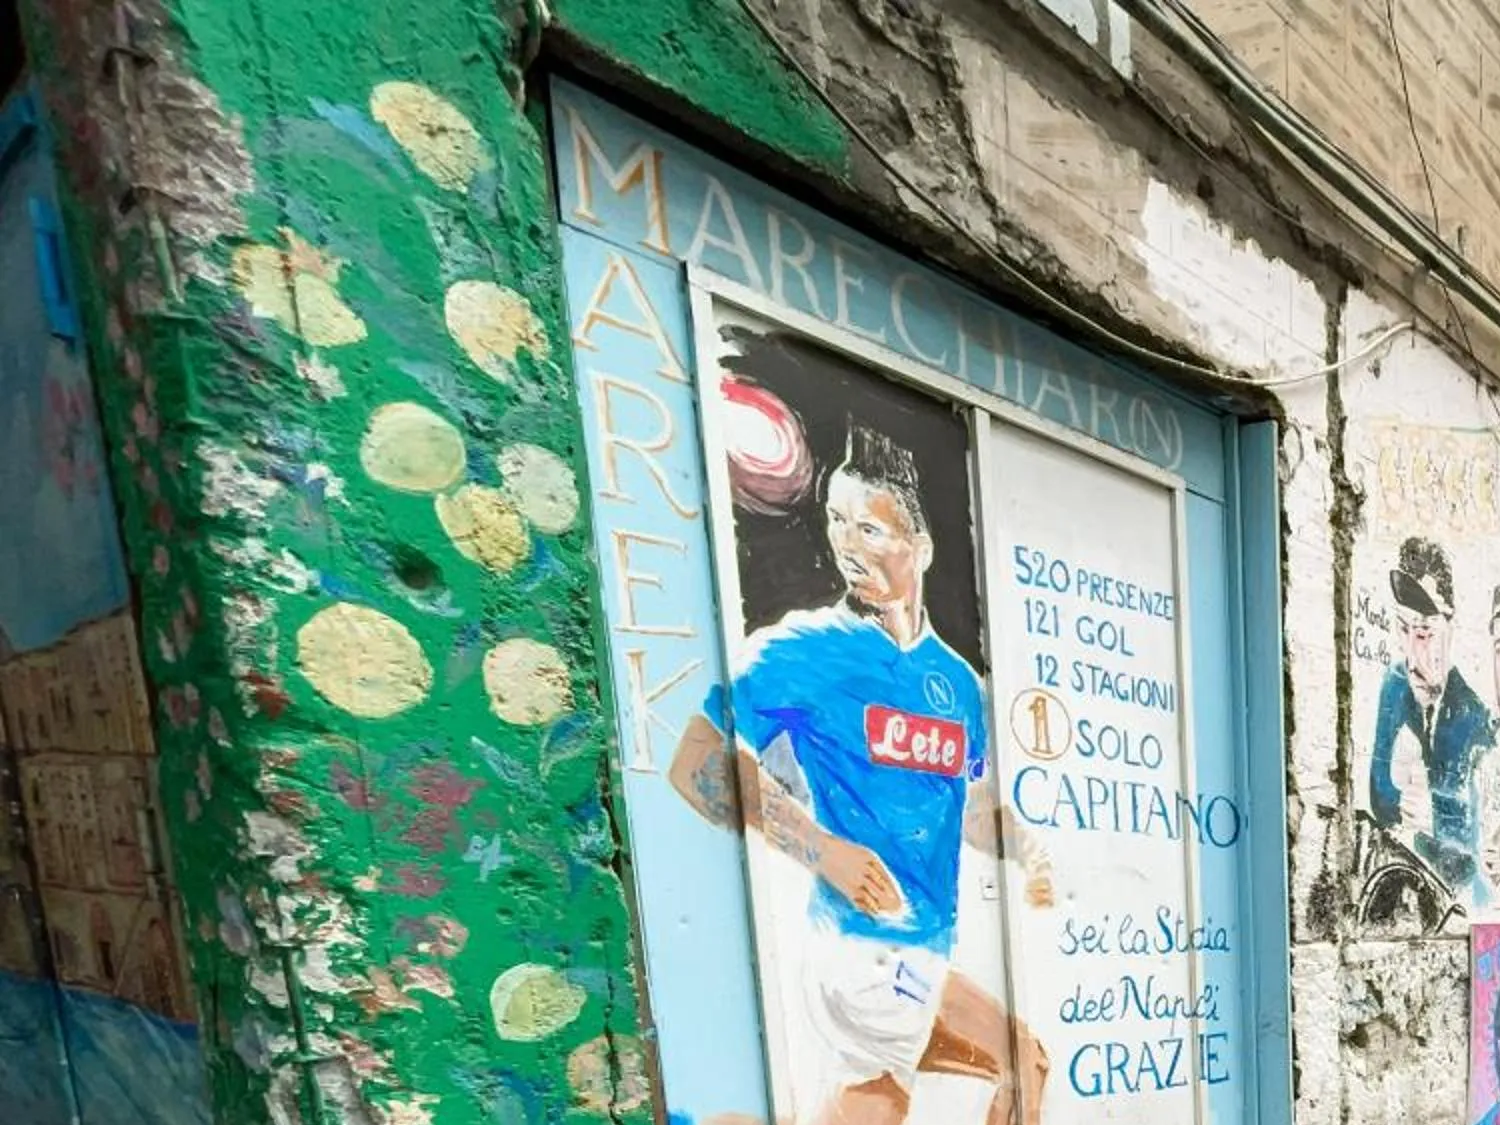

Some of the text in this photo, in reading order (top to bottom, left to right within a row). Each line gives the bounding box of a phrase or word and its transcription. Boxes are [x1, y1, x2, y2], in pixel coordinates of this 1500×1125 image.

[1013, 546, 1175, 621] 520 PRESENZE
[1024, 597, 1135, 657] 121 GOL
[1035, 653, 1175, 713] 12 STAGIONI
[871, 714, 957, 767] Lete
[1075, 719, 1163, 769] SOLO
[1013, 766, 1241, 848] CAPITANO
[1118, 914, 1150, 954] la
[1060, 983, 1116, 1024] del
[1069, 1032, 1230, 1097] GRAZIE
